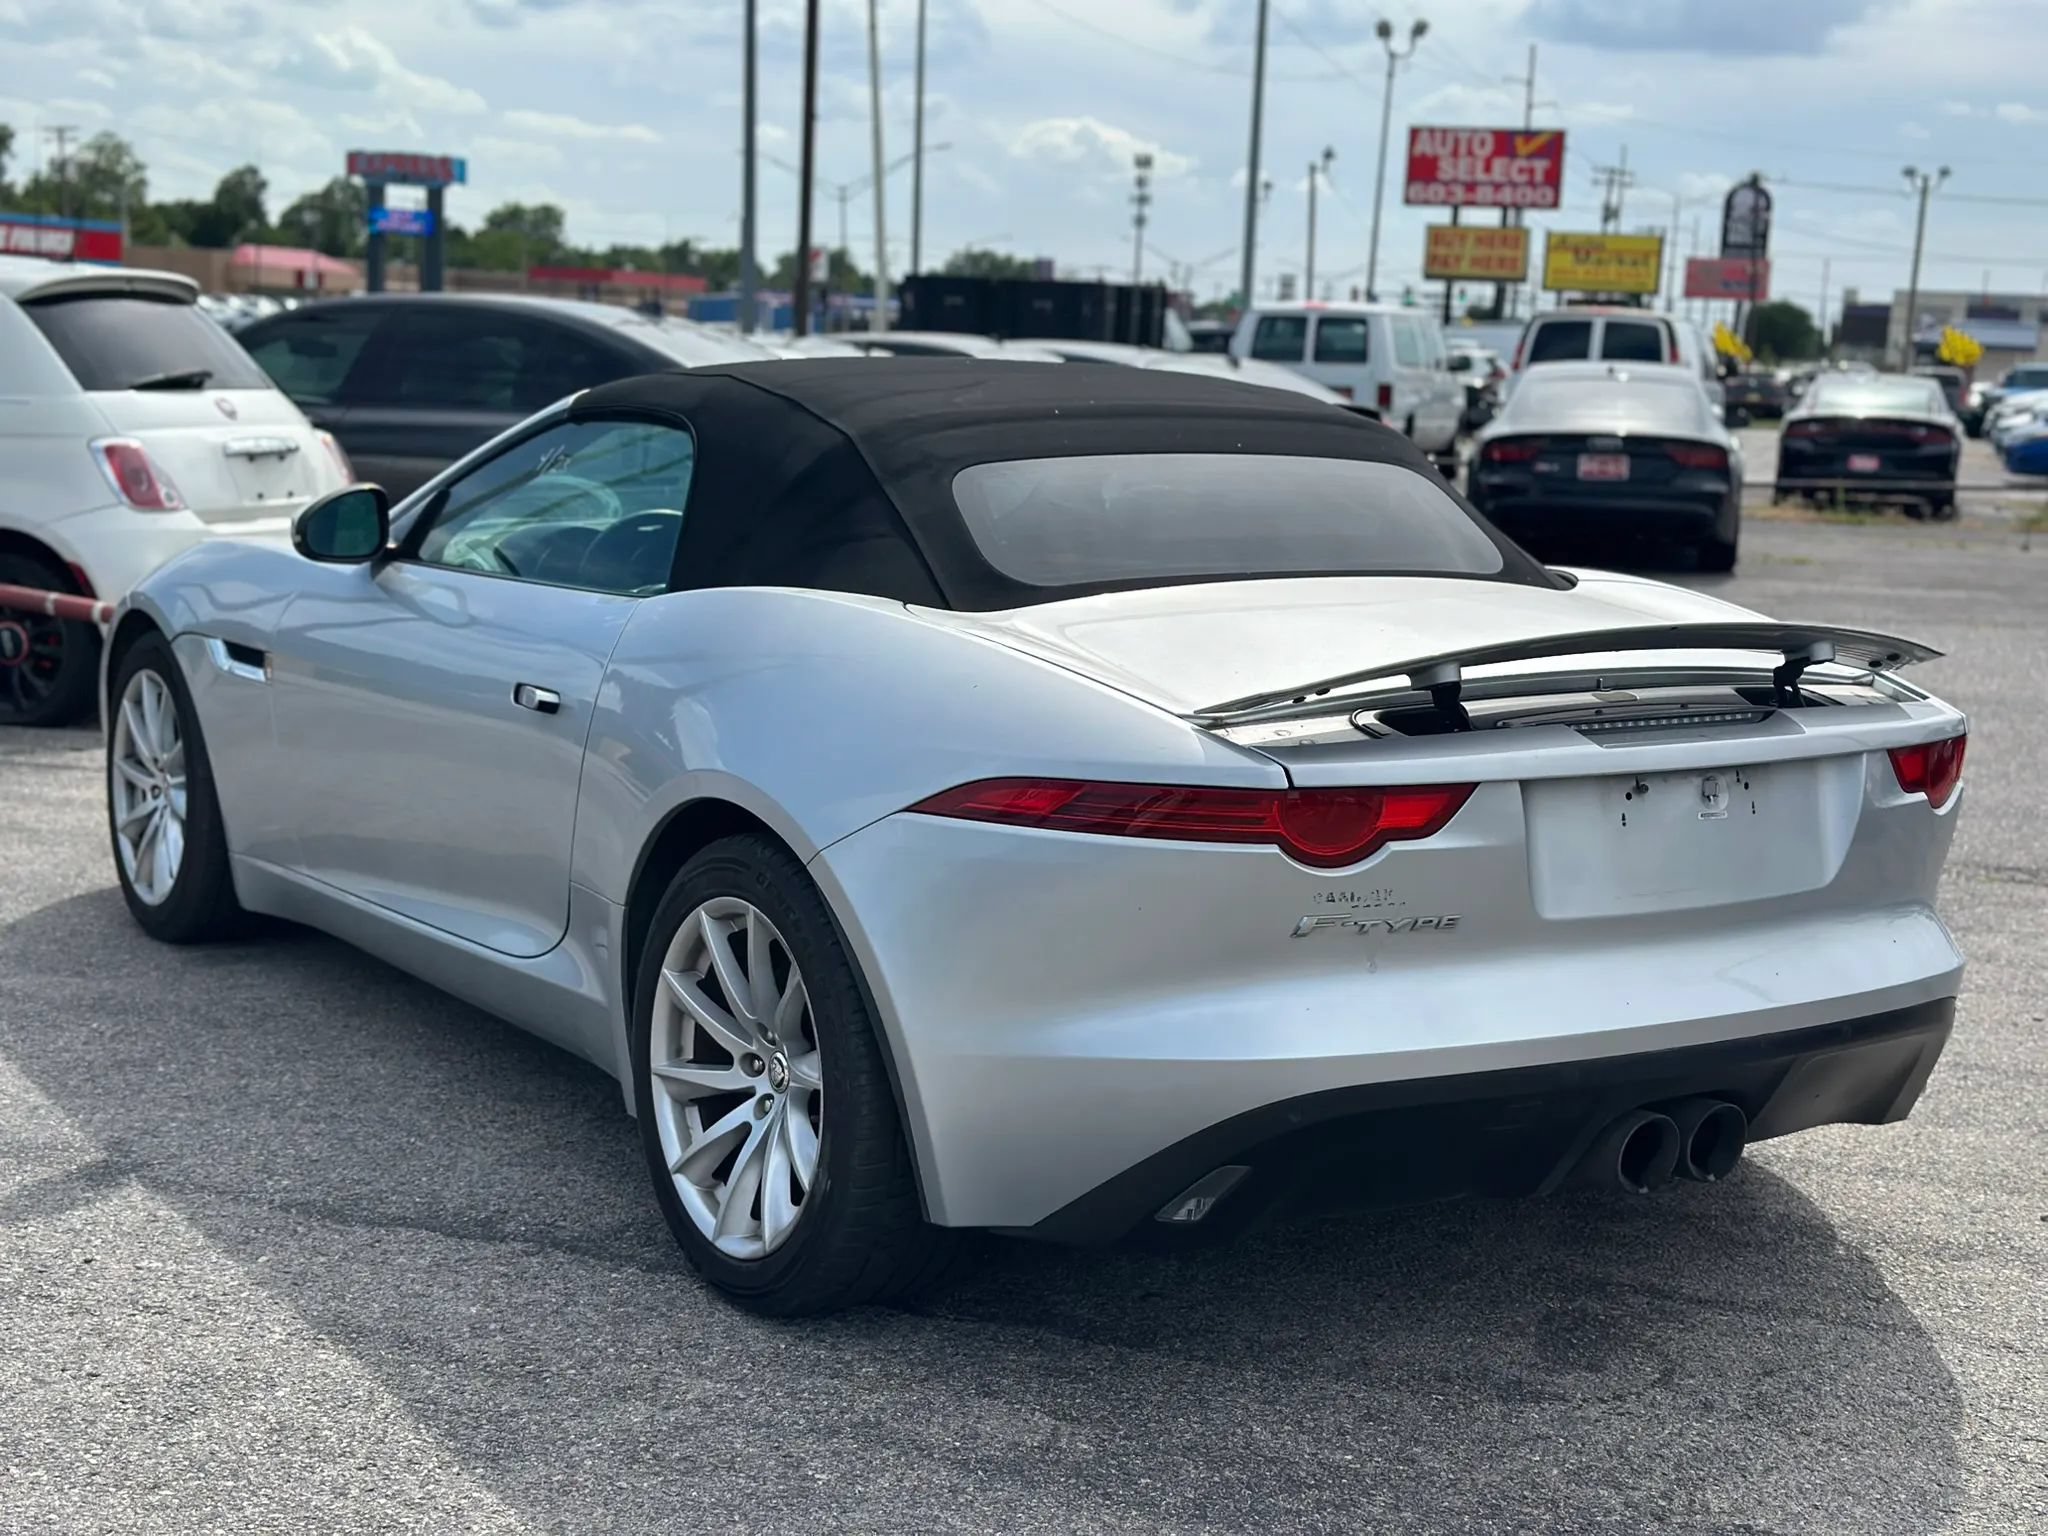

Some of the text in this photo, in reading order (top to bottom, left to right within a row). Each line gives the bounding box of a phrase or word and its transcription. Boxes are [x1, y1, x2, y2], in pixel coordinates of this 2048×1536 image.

[1413, 131, 1494, 157] AUTO
[1436, 156, 1551, 183] SELECT
[1408, 183, 1555, 206] 603-8400
[1290, 913, 1463, 938] F-TYPE
